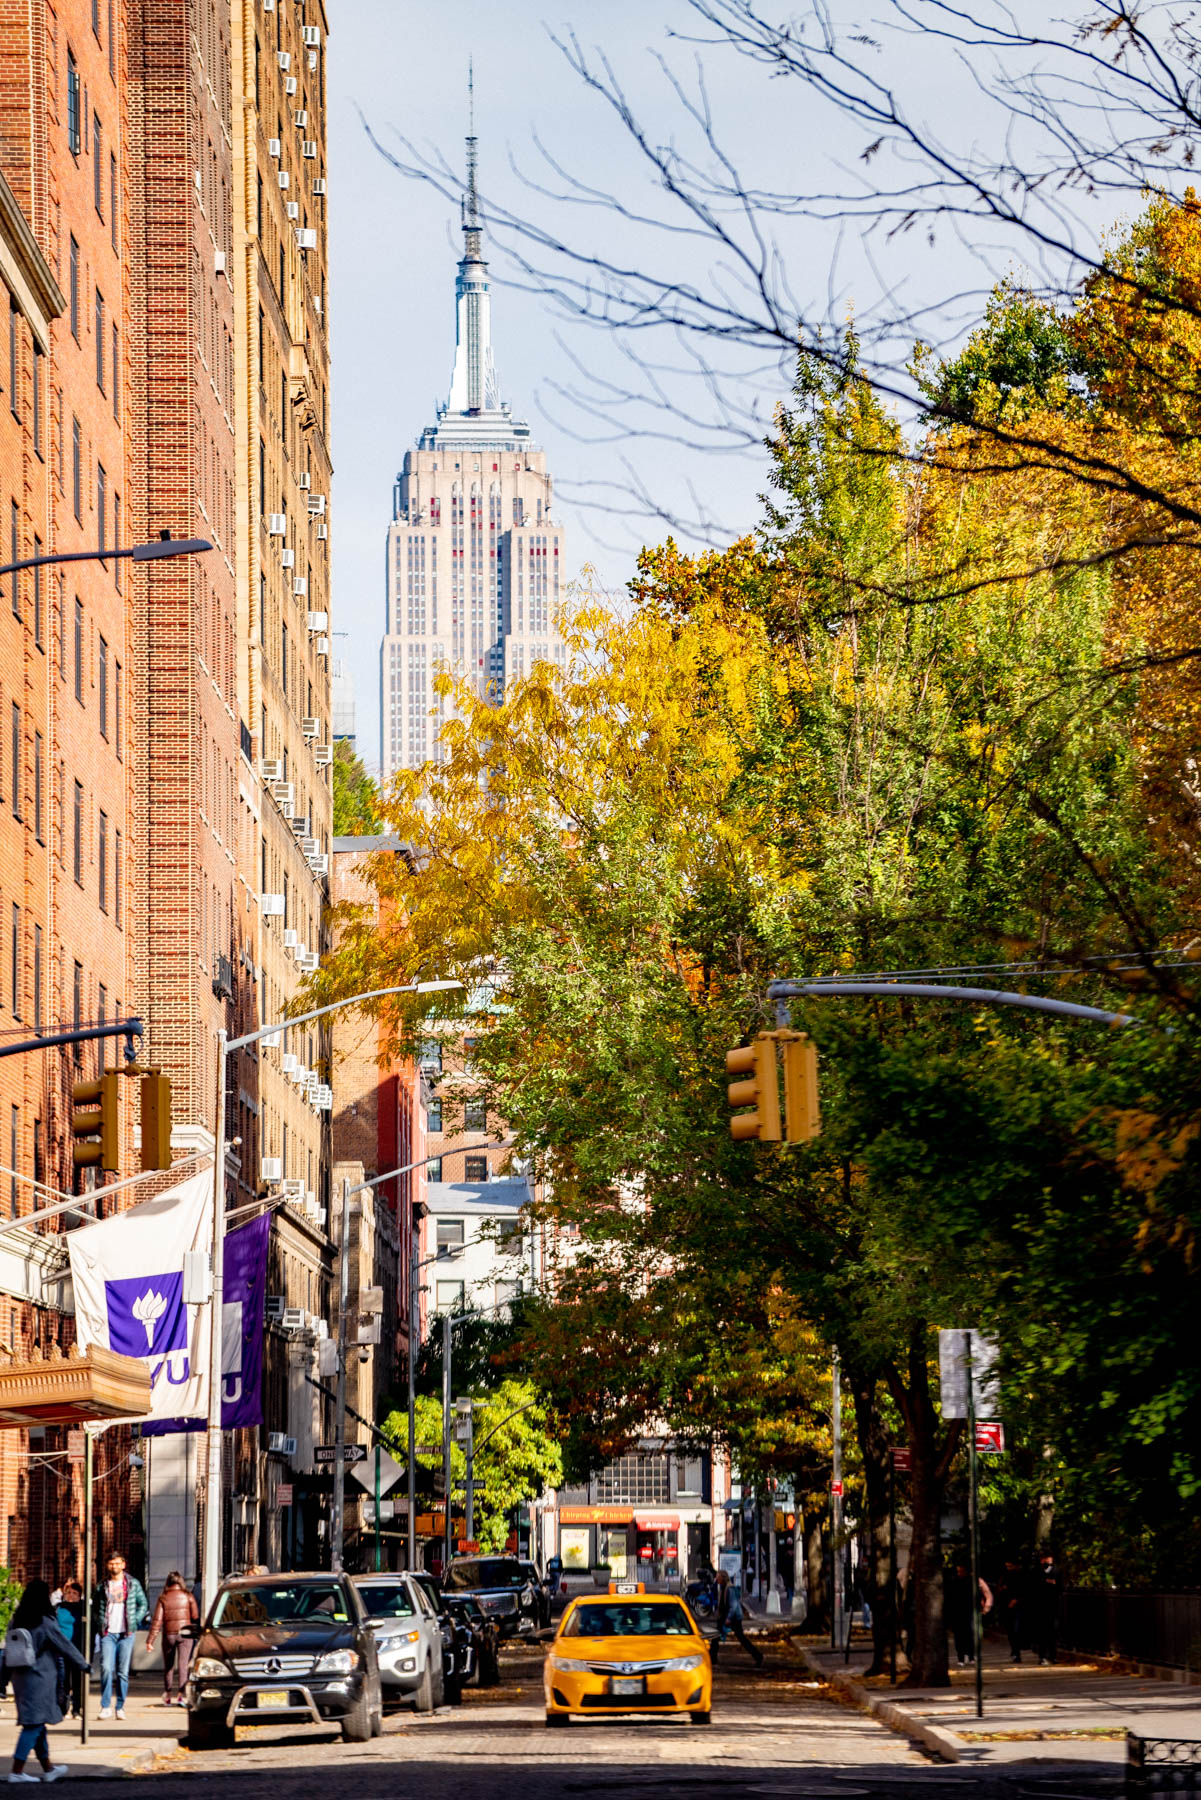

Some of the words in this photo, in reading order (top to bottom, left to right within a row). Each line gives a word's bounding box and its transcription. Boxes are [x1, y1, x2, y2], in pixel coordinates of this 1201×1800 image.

[151, 1357, 190, 1390] YU
[344, 1449, 359, 1458] WAY
[605, 1511, 632, 1520] Chicken
